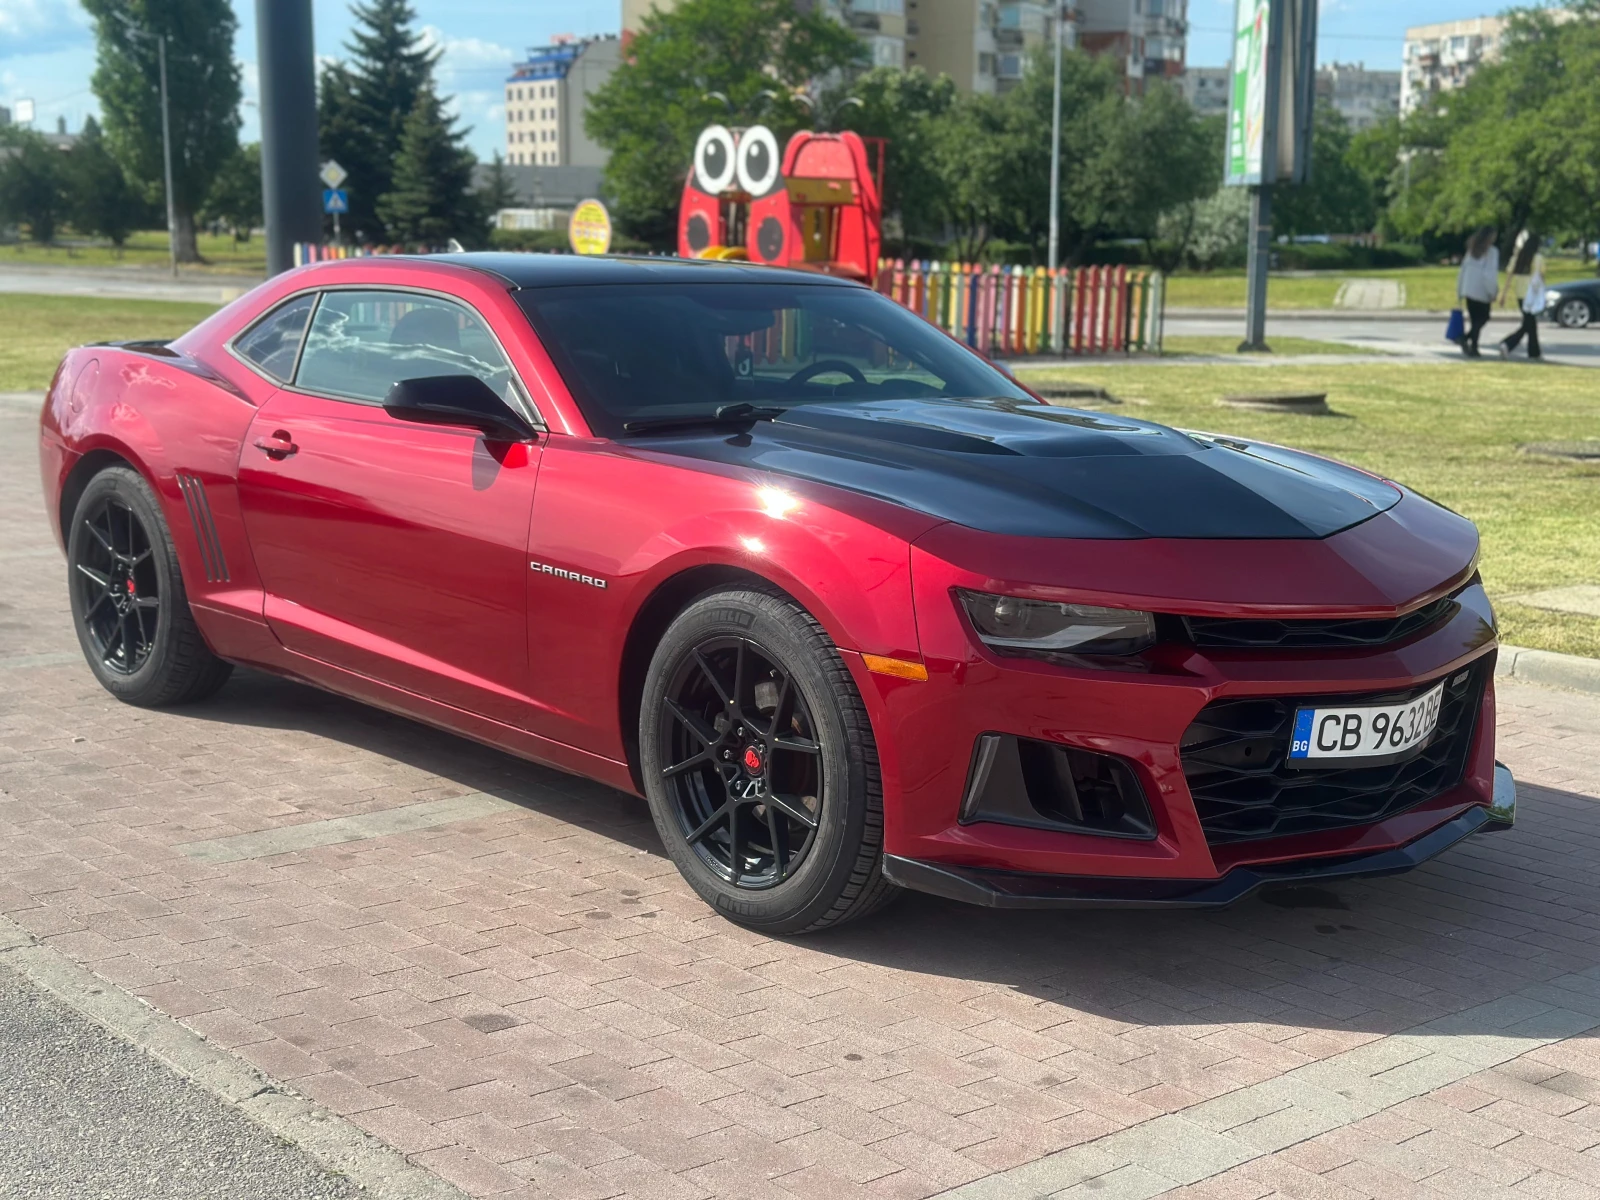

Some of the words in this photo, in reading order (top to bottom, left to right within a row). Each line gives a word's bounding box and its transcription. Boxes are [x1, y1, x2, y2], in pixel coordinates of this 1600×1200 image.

[530, 561, 607, 588] CAMARO
[688, 609, 751, 627] ICHELIN
[1316, 714, 1362, 752] CB
[1292, 740, 1308, 752] BG
